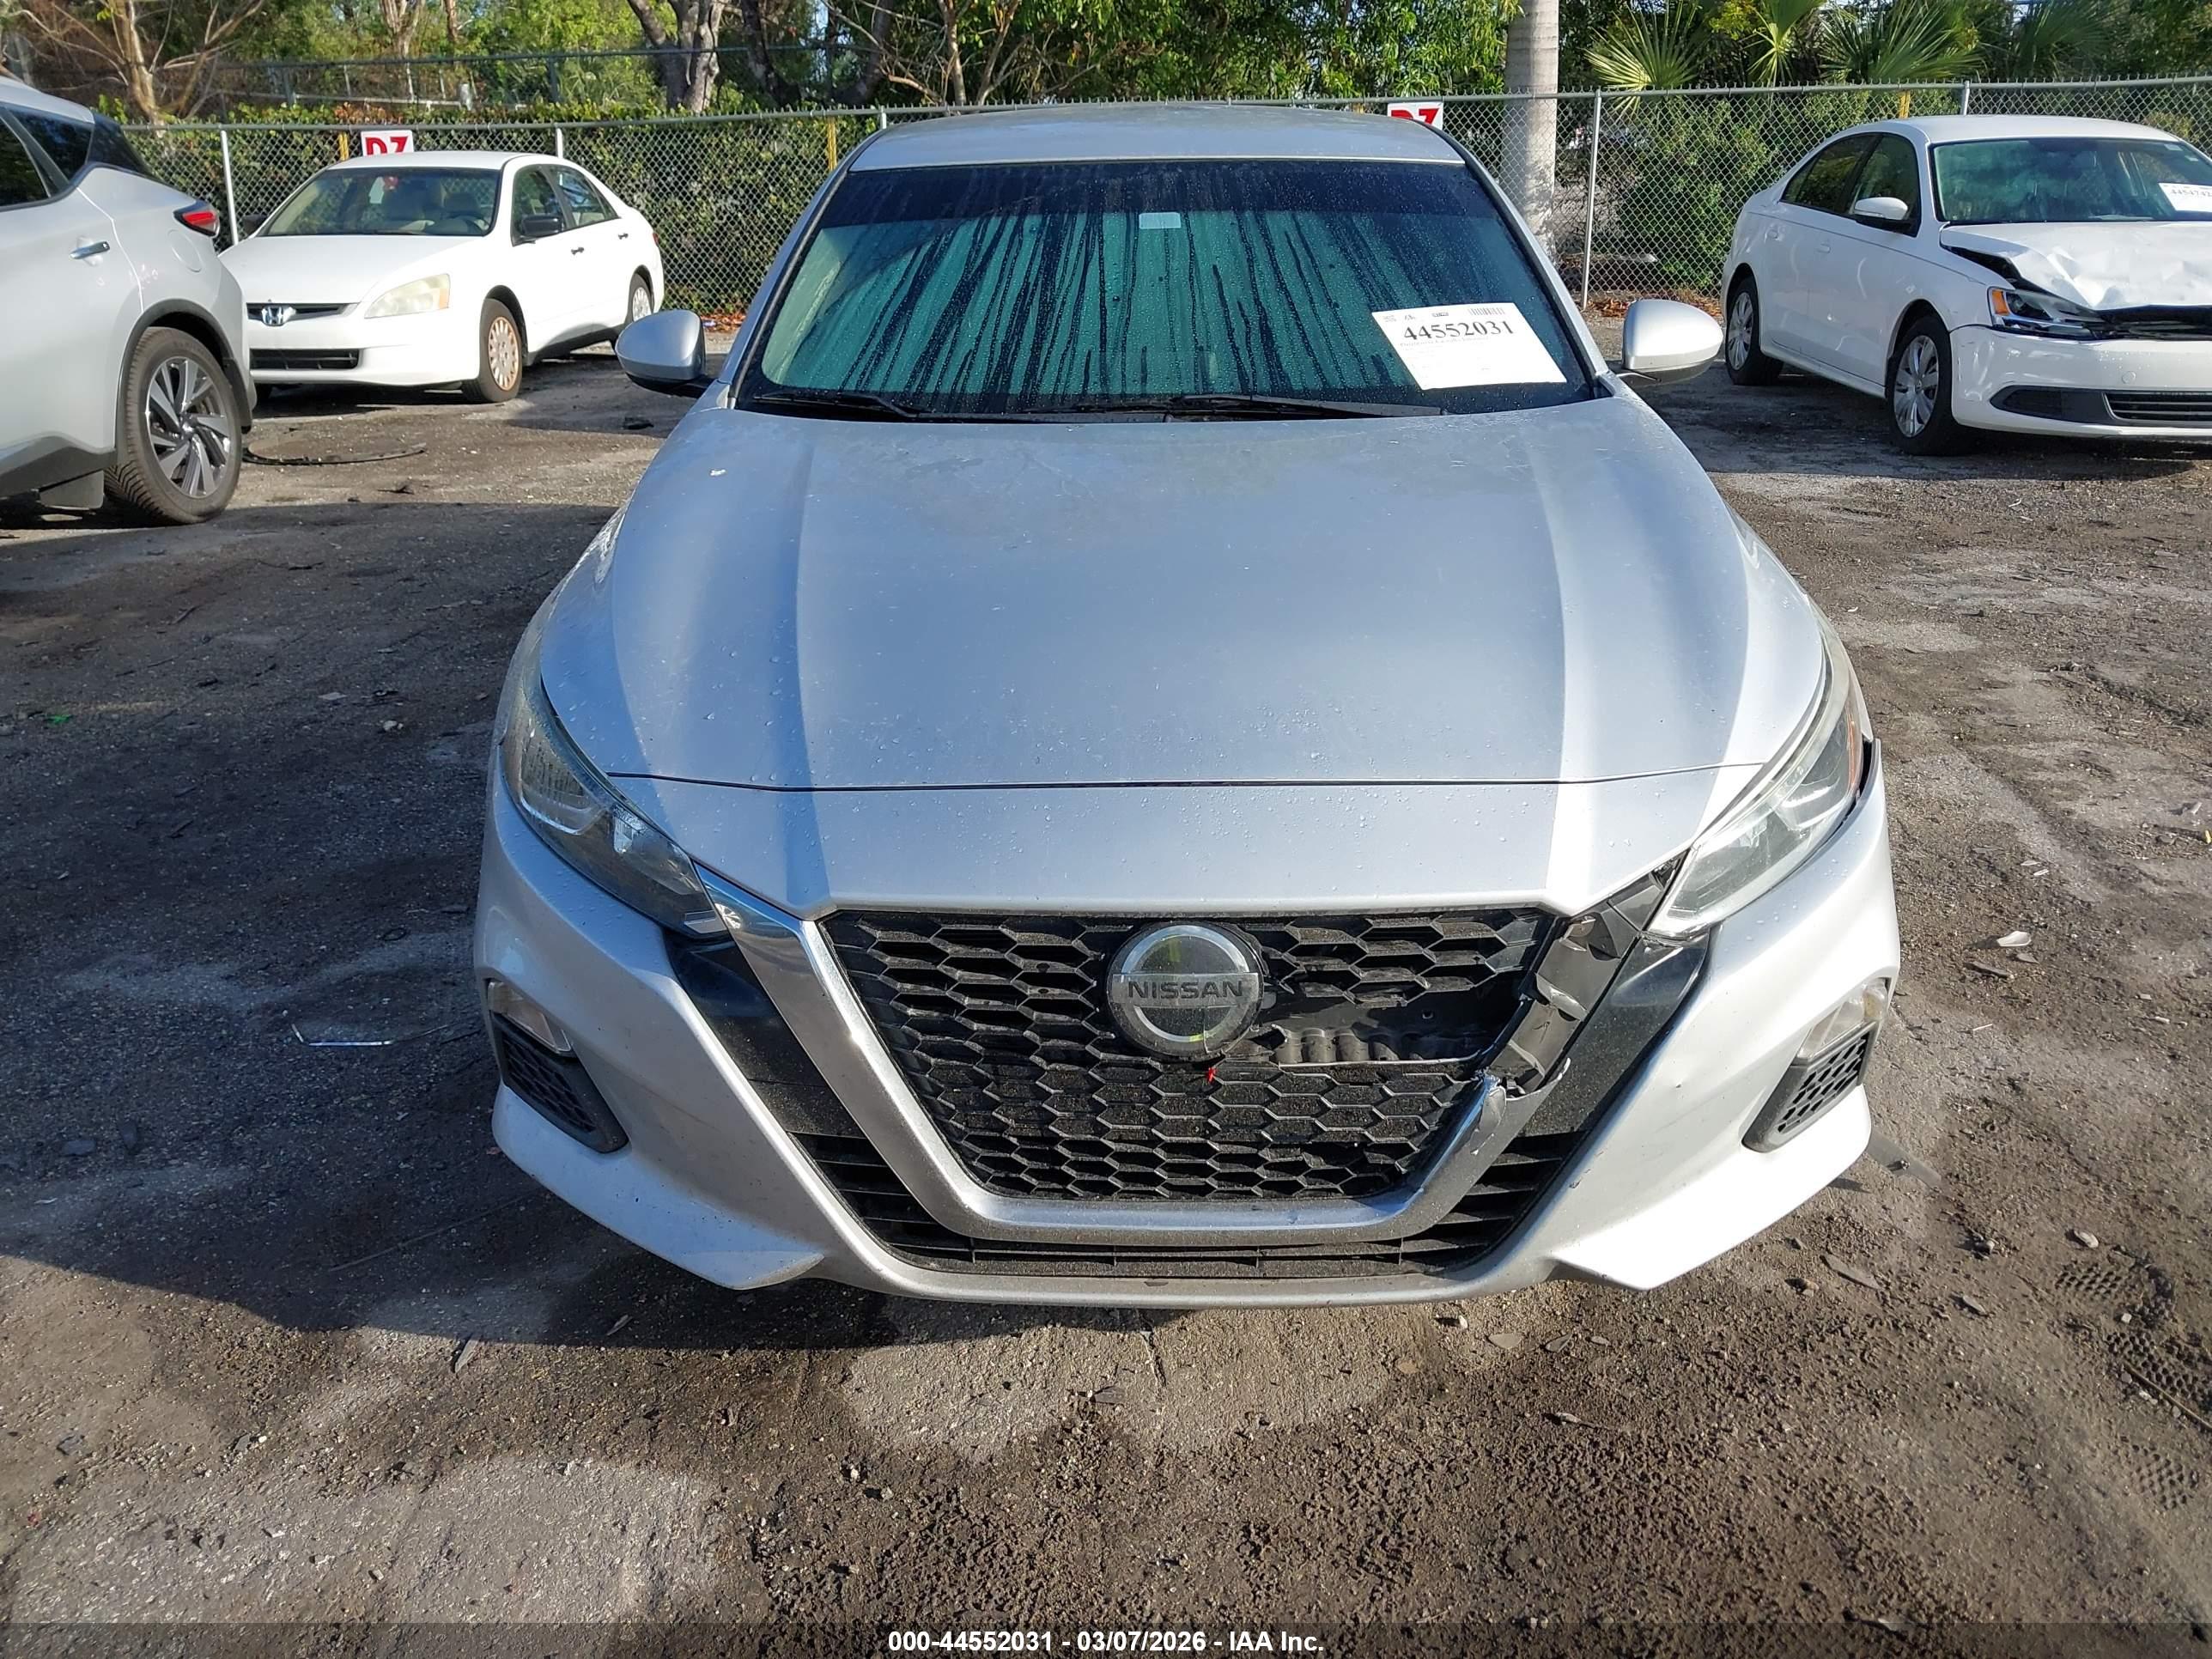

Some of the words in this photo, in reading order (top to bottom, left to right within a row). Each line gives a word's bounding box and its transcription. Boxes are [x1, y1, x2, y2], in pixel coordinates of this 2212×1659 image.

[365, 137, 409, 155] D7
[1403, 320, 1514, 340] 44552031
[1127, 980, 1243, 1000] NISSAN
